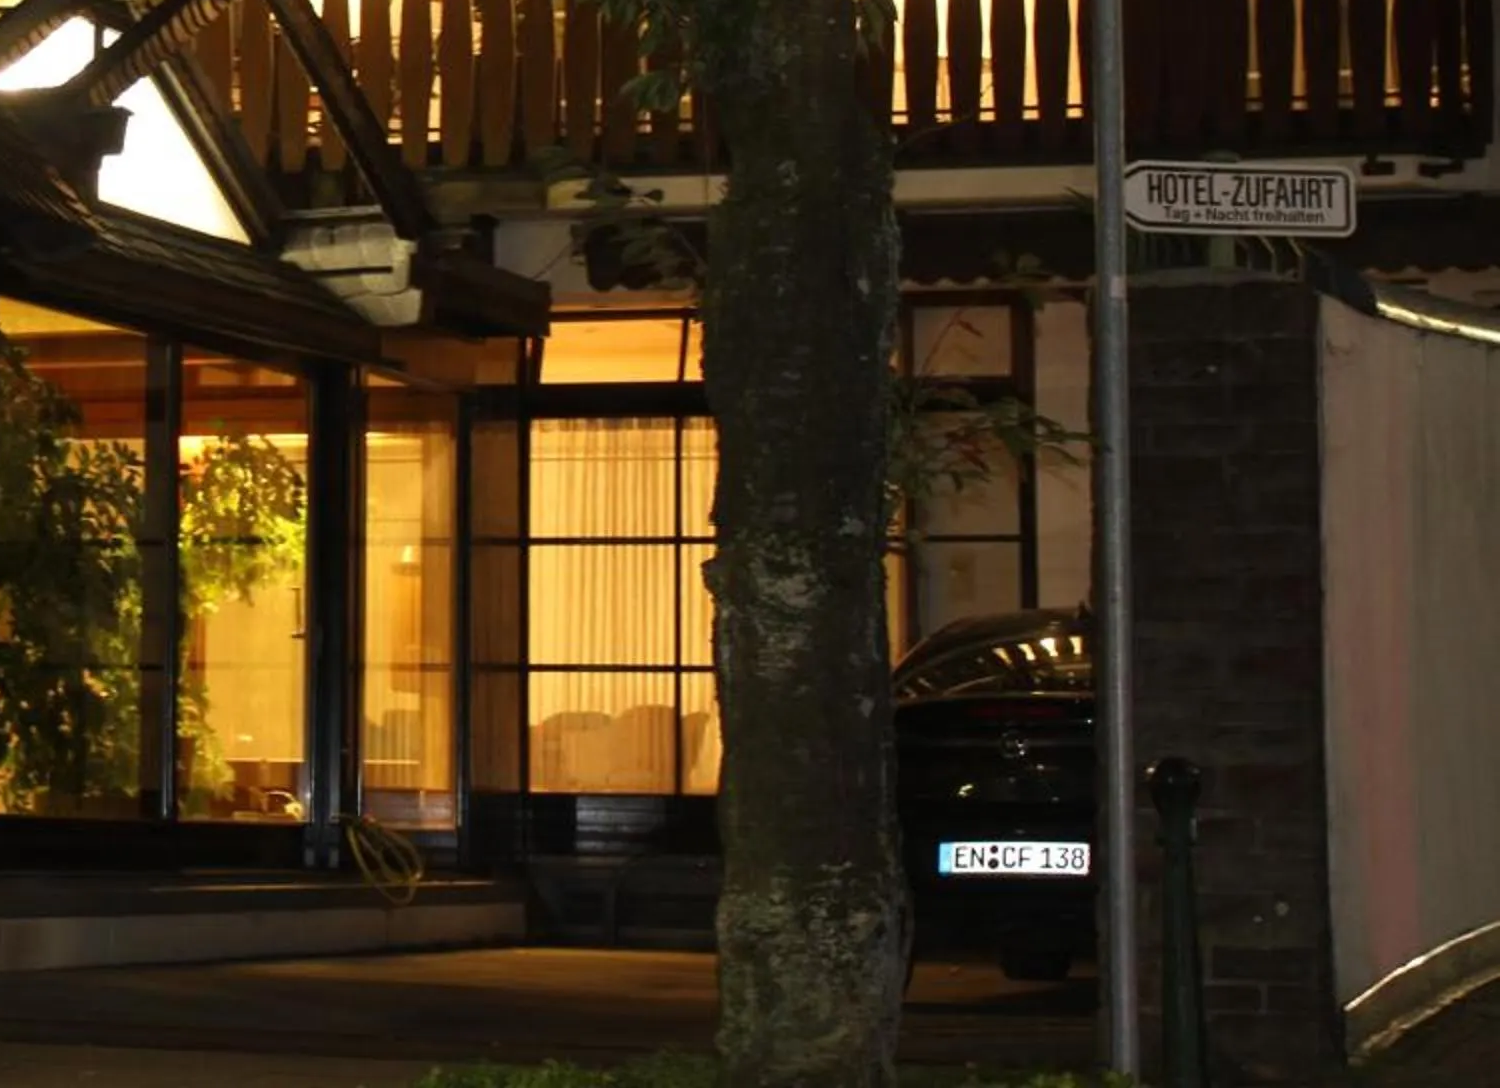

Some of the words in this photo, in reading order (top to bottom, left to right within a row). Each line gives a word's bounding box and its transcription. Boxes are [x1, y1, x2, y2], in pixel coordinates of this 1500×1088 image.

[1147, 173, 1337, 209] HOTEL-ZUFAHRT
[1162, 205, 1190, 223] Tag
[1205, 208, 1250, 222] Nacht
[1253, 209, 1325, 224] freihalten
[1040, 847, 1086, 869] 138
